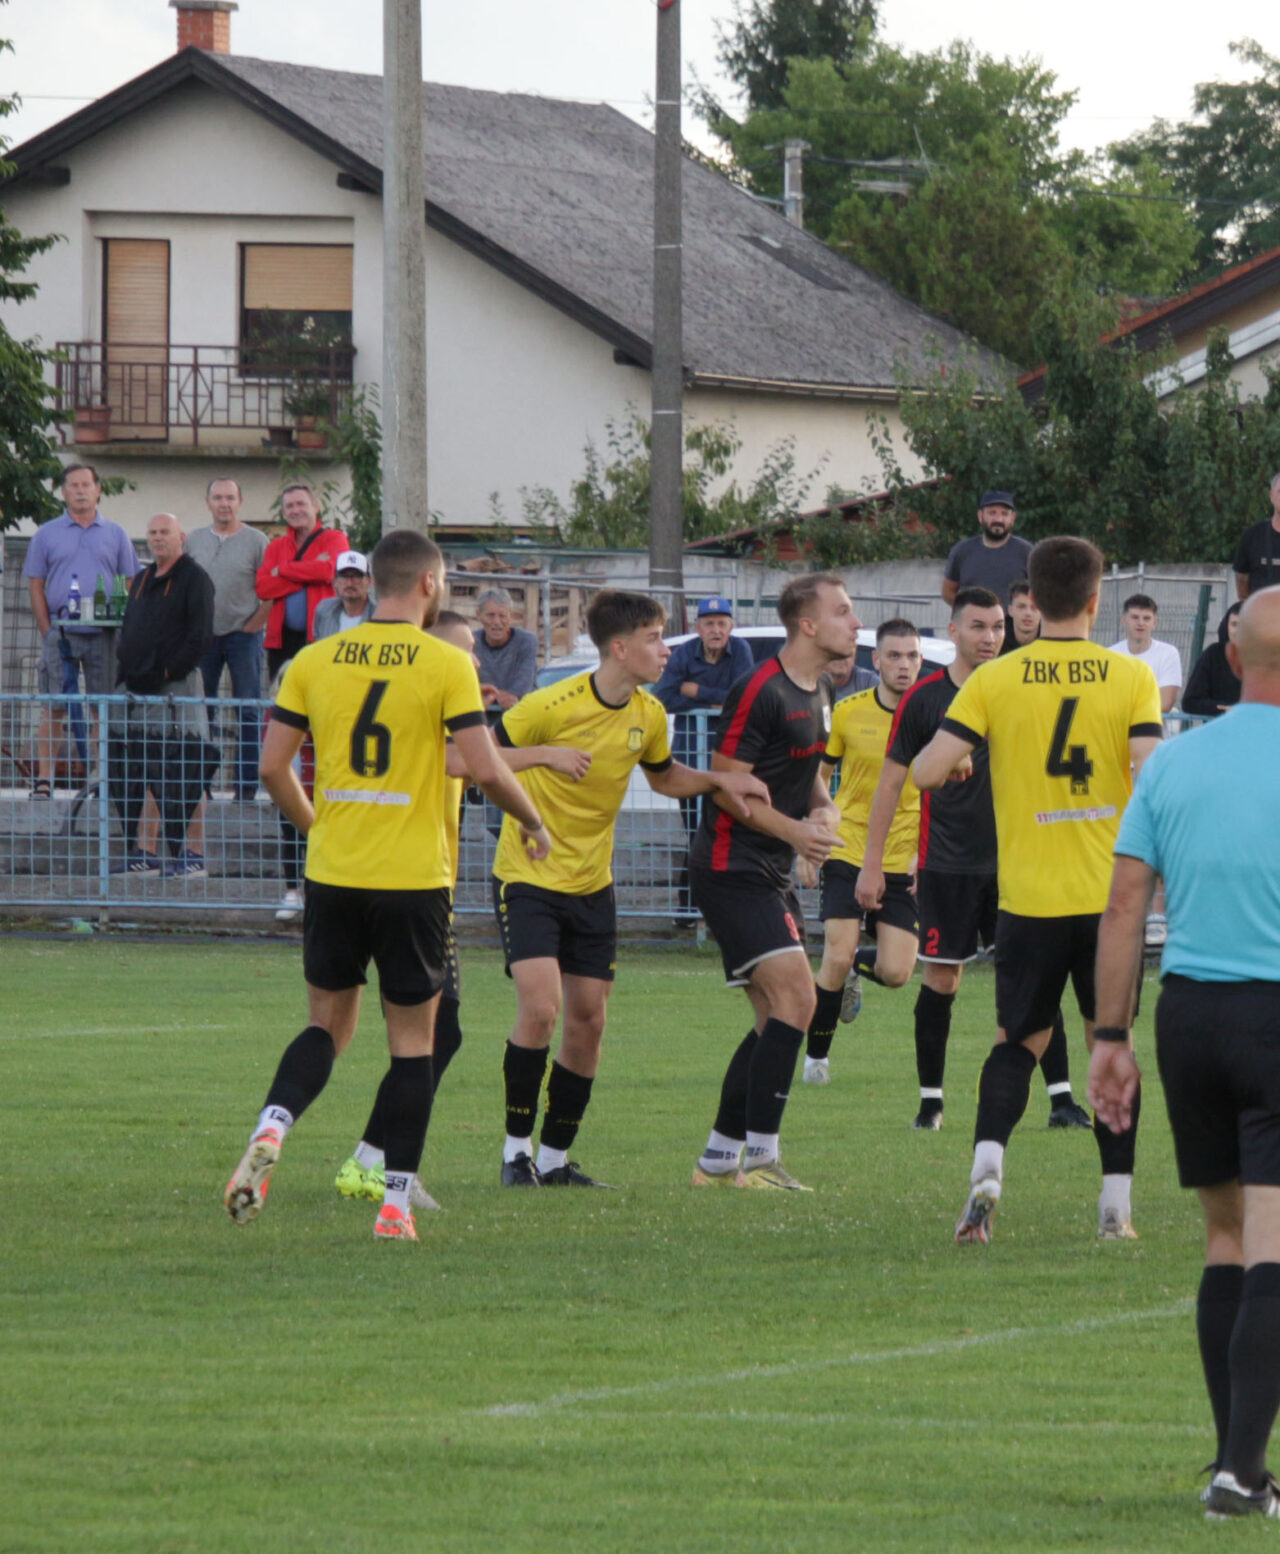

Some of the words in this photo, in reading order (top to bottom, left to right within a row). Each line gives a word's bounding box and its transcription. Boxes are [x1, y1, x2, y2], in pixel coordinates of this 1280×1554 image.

[333, 640, 373, 665] ŽBK
[378, 644, 420, 666] BSV
[1022, 658, 1061, 684] ŽBK
[1068, 660, 1109, 684] BSV
[351, 679, 391, 778] 6
[1045, 697, 1093, 795] 4
[925, 927, 940, 955] 2
